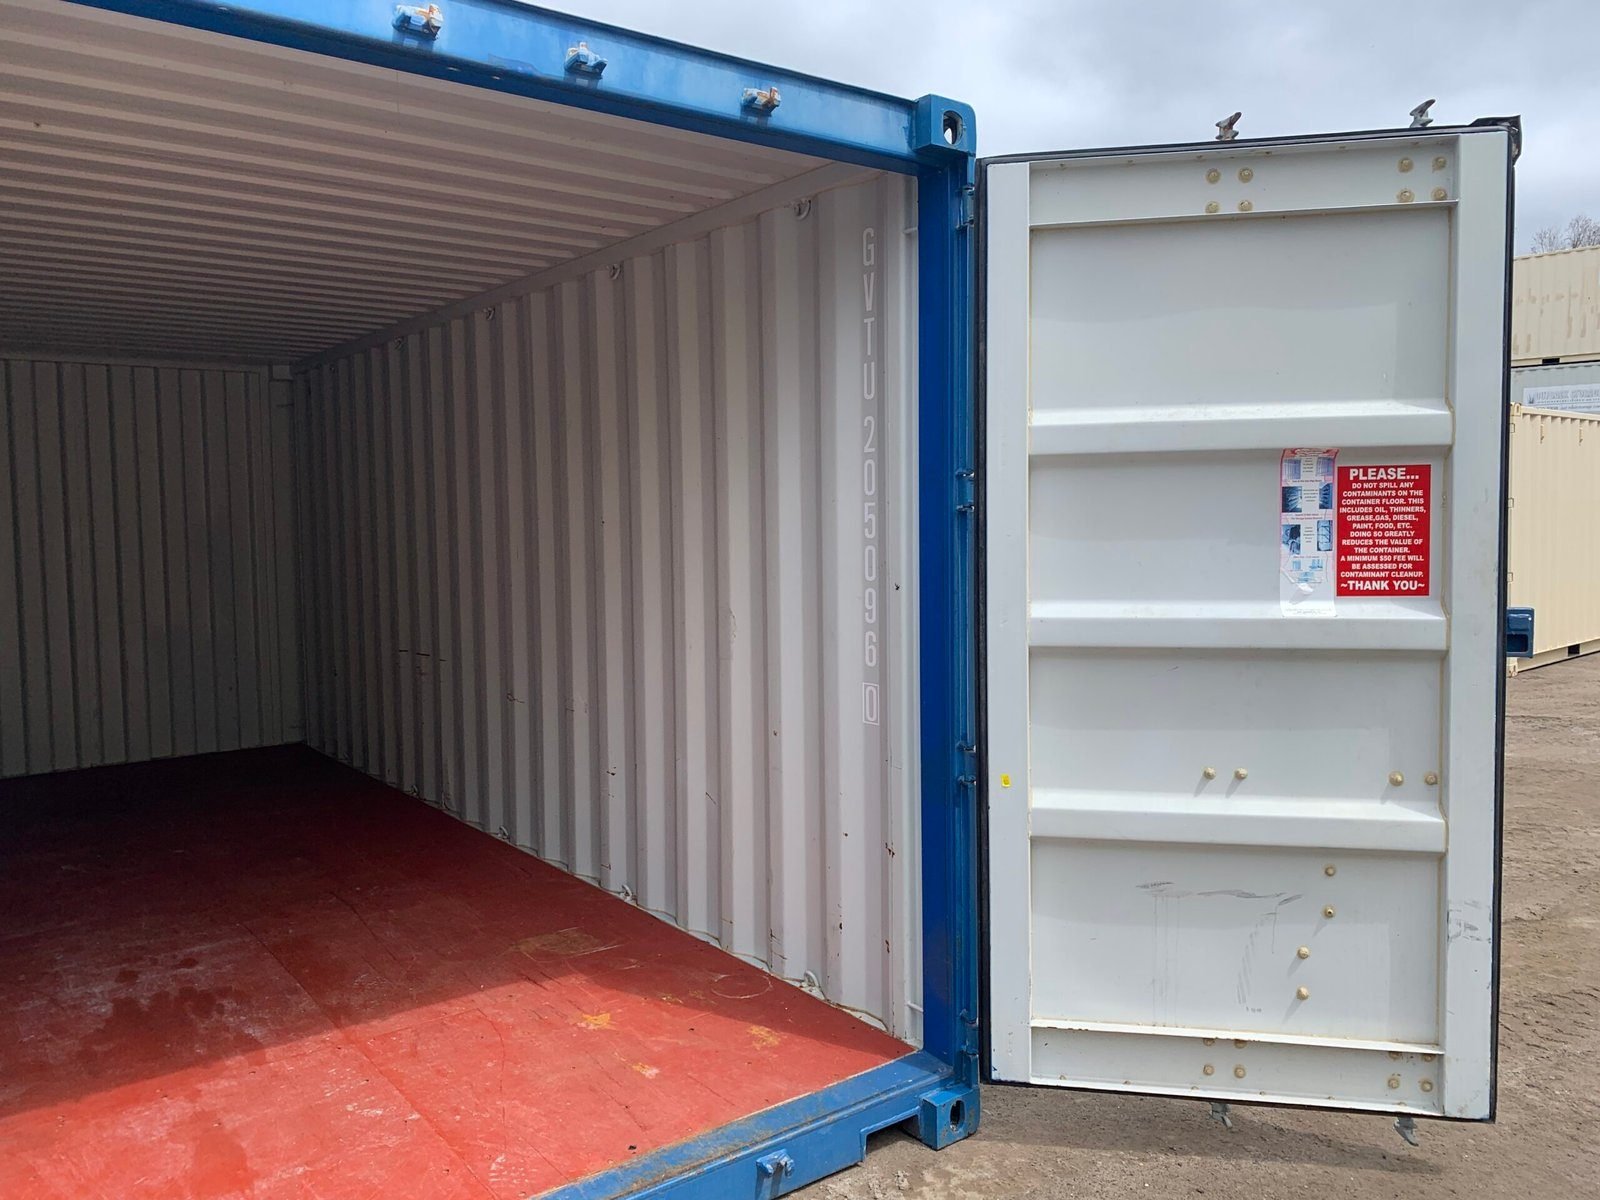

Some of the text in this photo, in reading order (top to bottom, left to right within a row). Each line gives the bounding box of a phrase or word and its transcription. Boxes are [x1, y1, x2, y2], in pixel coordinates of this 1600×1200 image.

[863, 227, 875, 400] GVTU
[863, 415, 877, 668] 205096
[1350, 468, 1419, 480] PLEASE...
